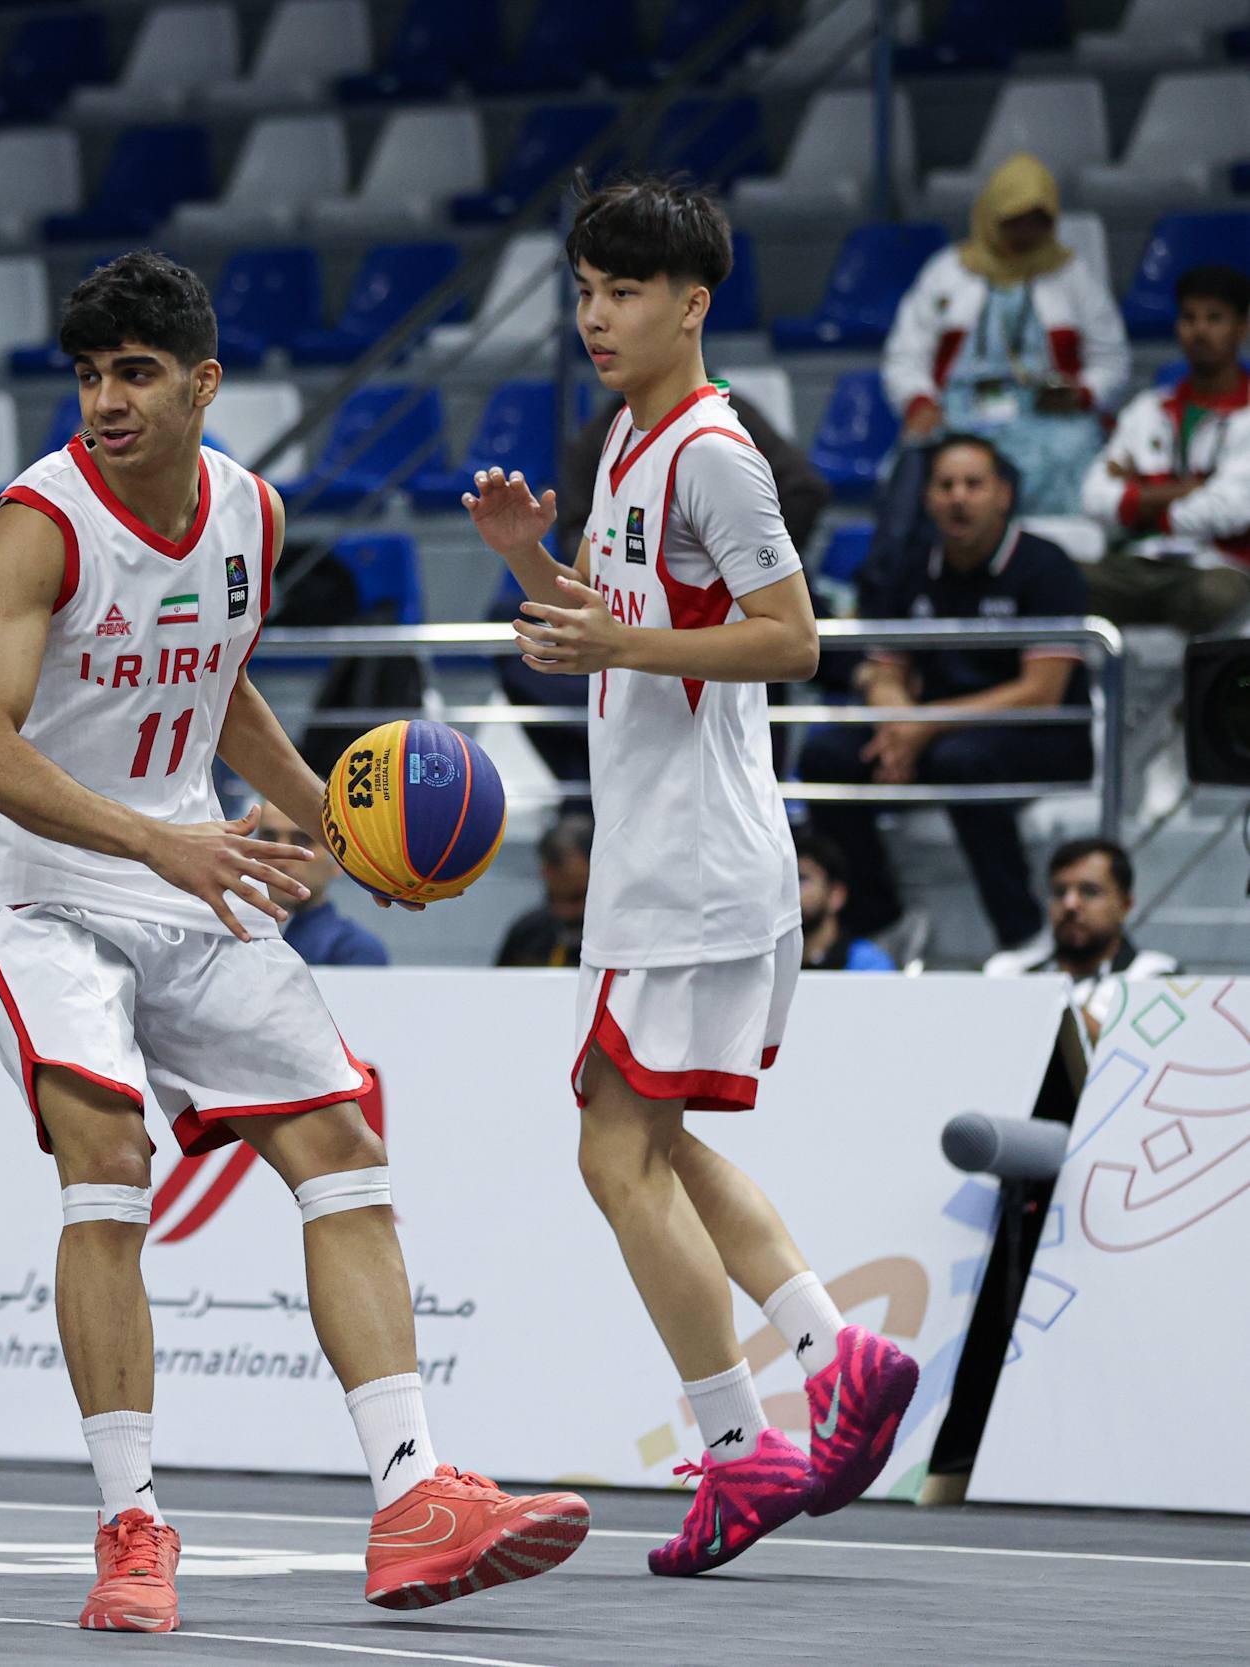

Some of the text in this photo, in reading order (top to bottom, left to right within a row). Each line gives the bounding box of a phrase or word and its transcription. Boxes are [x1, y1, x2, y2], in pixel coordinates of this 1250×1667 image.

[230, 590, 246, 603] FIBA
[96, 621, 132, 637] PEAK
[130, 708, 194, 779] 11
[382, 766, 390, 801] OFFICIAL
